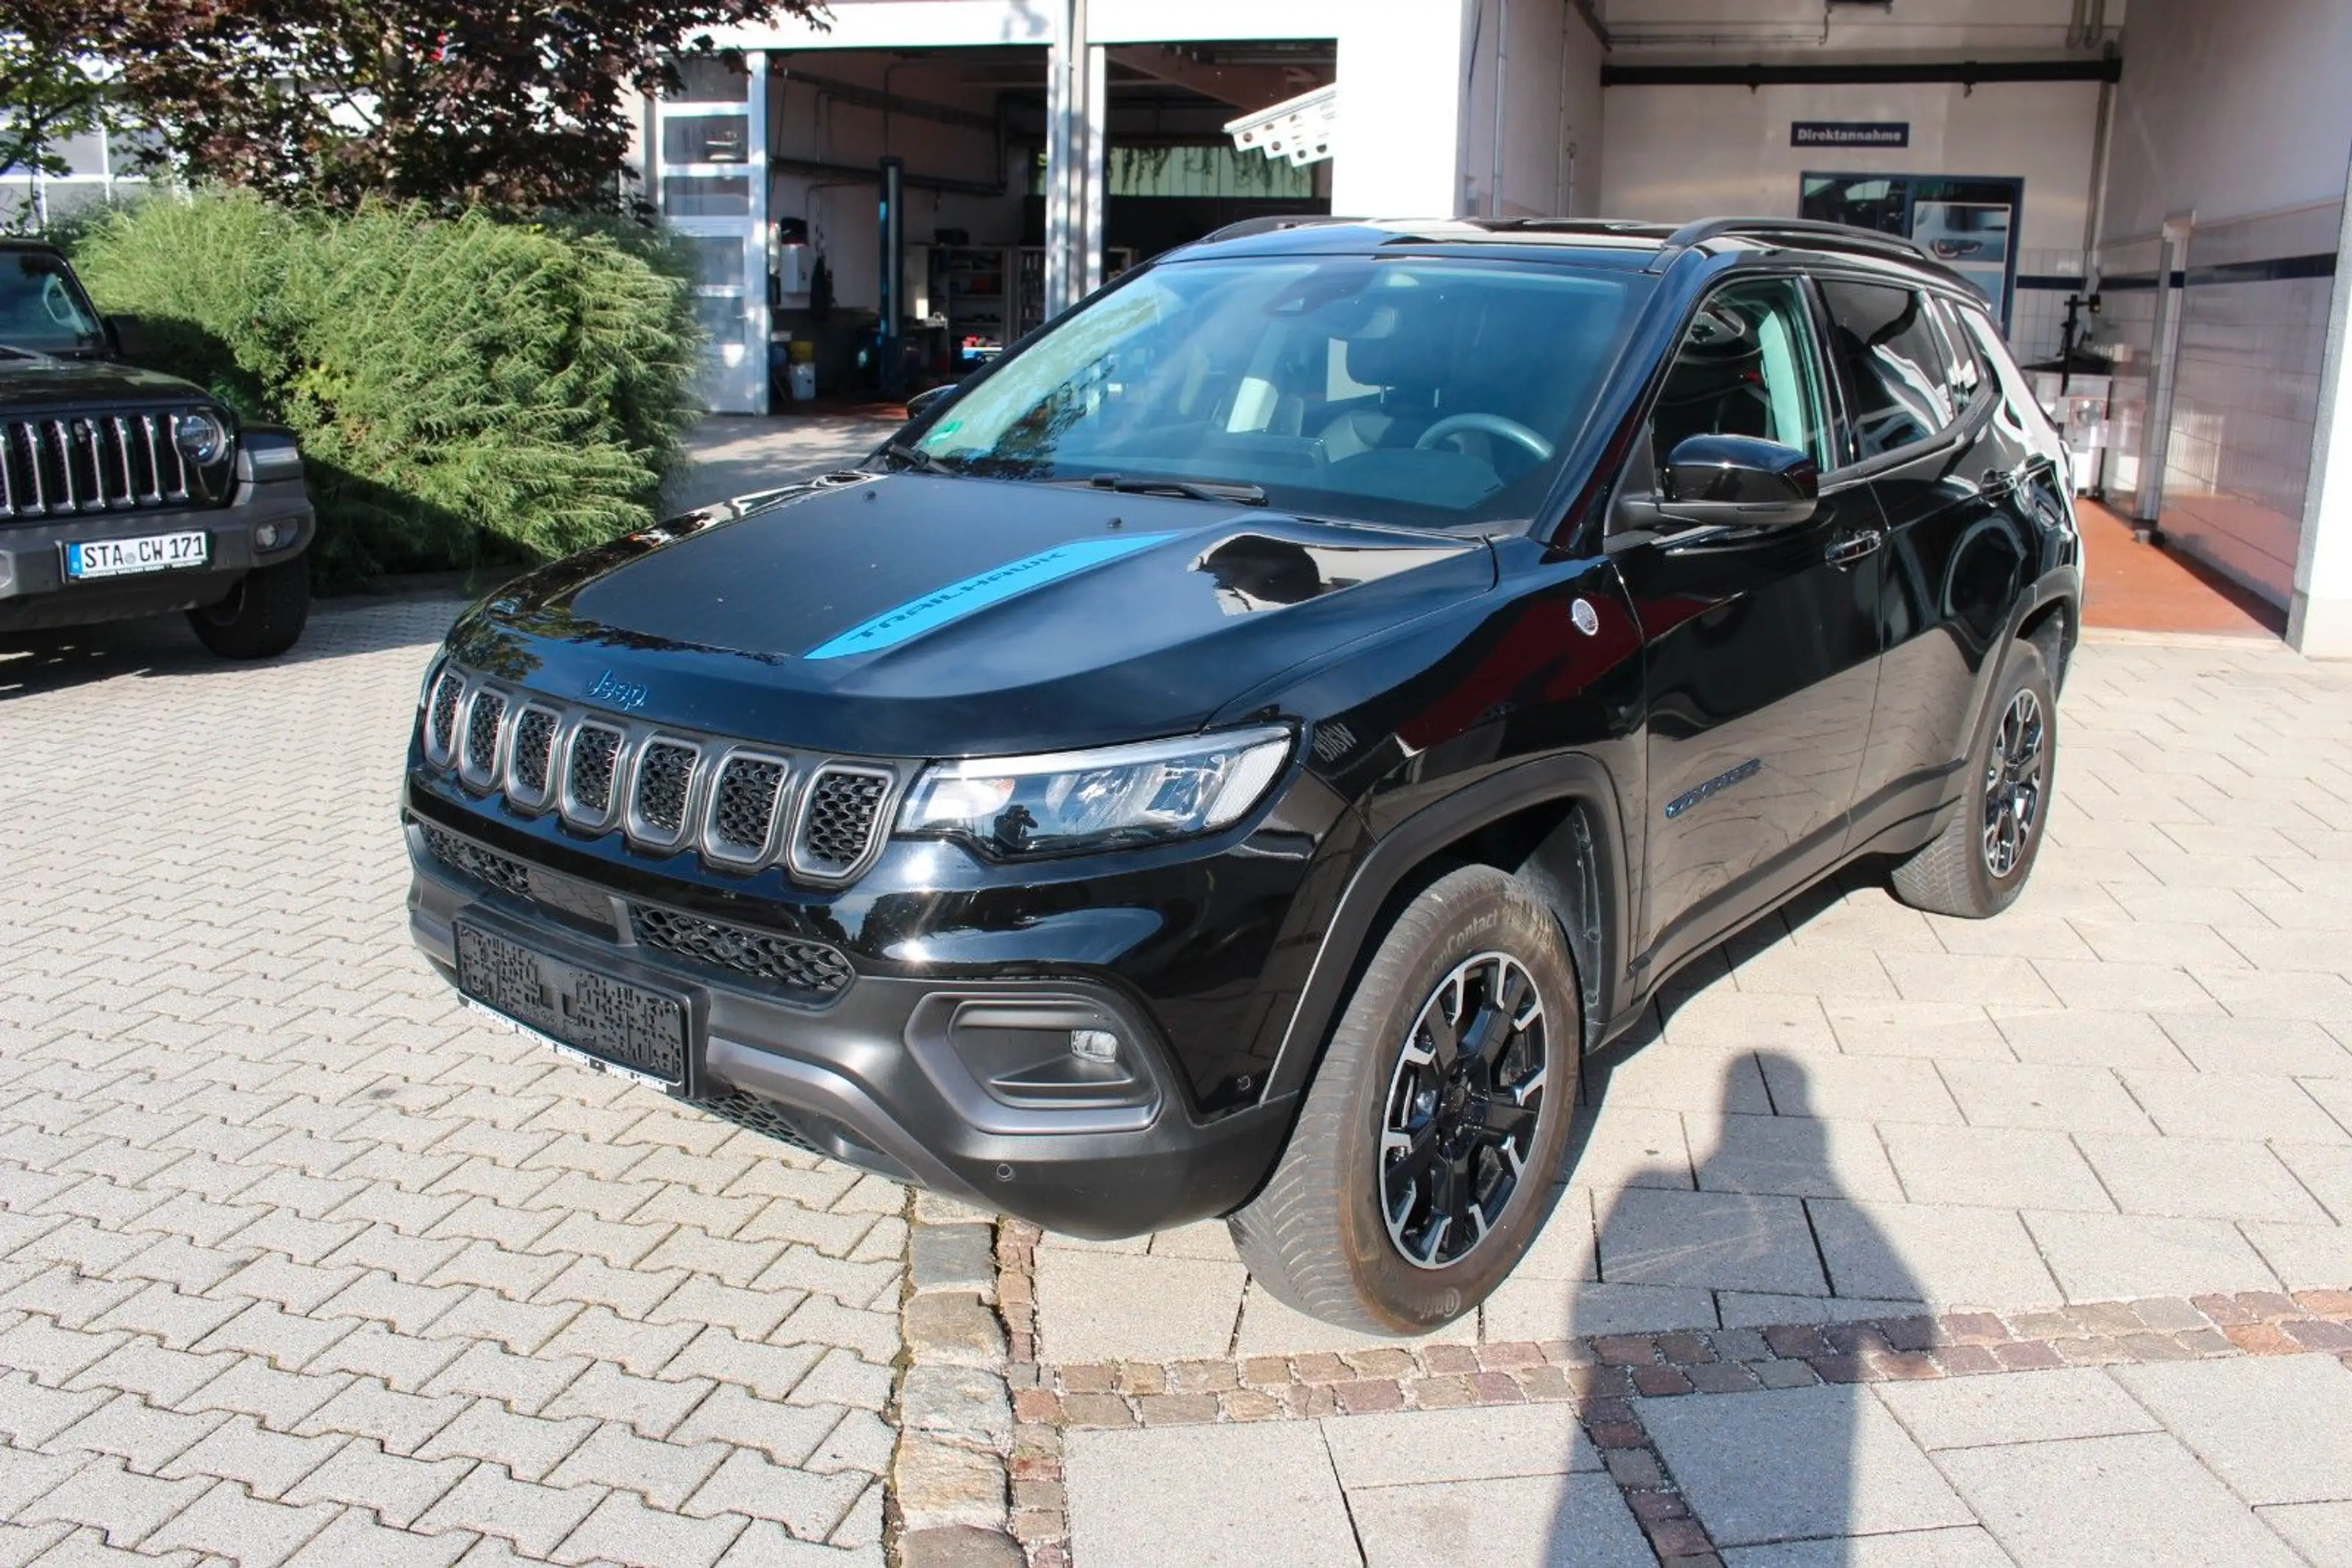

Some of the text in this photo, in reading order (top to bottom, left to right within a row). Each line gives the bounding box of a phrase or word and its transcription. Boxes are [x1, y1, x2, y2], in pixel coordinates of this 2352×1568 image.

[1797, 128, 1902, 141] Direktannahme
[84, 545, 124, 568] STA
[138, 540, 163, 562] CW
[169, 535, 204, 559] 171
[845, 552, 1068, 642] TRAILHAWK
[586, 669, 649, 711] Jeep
